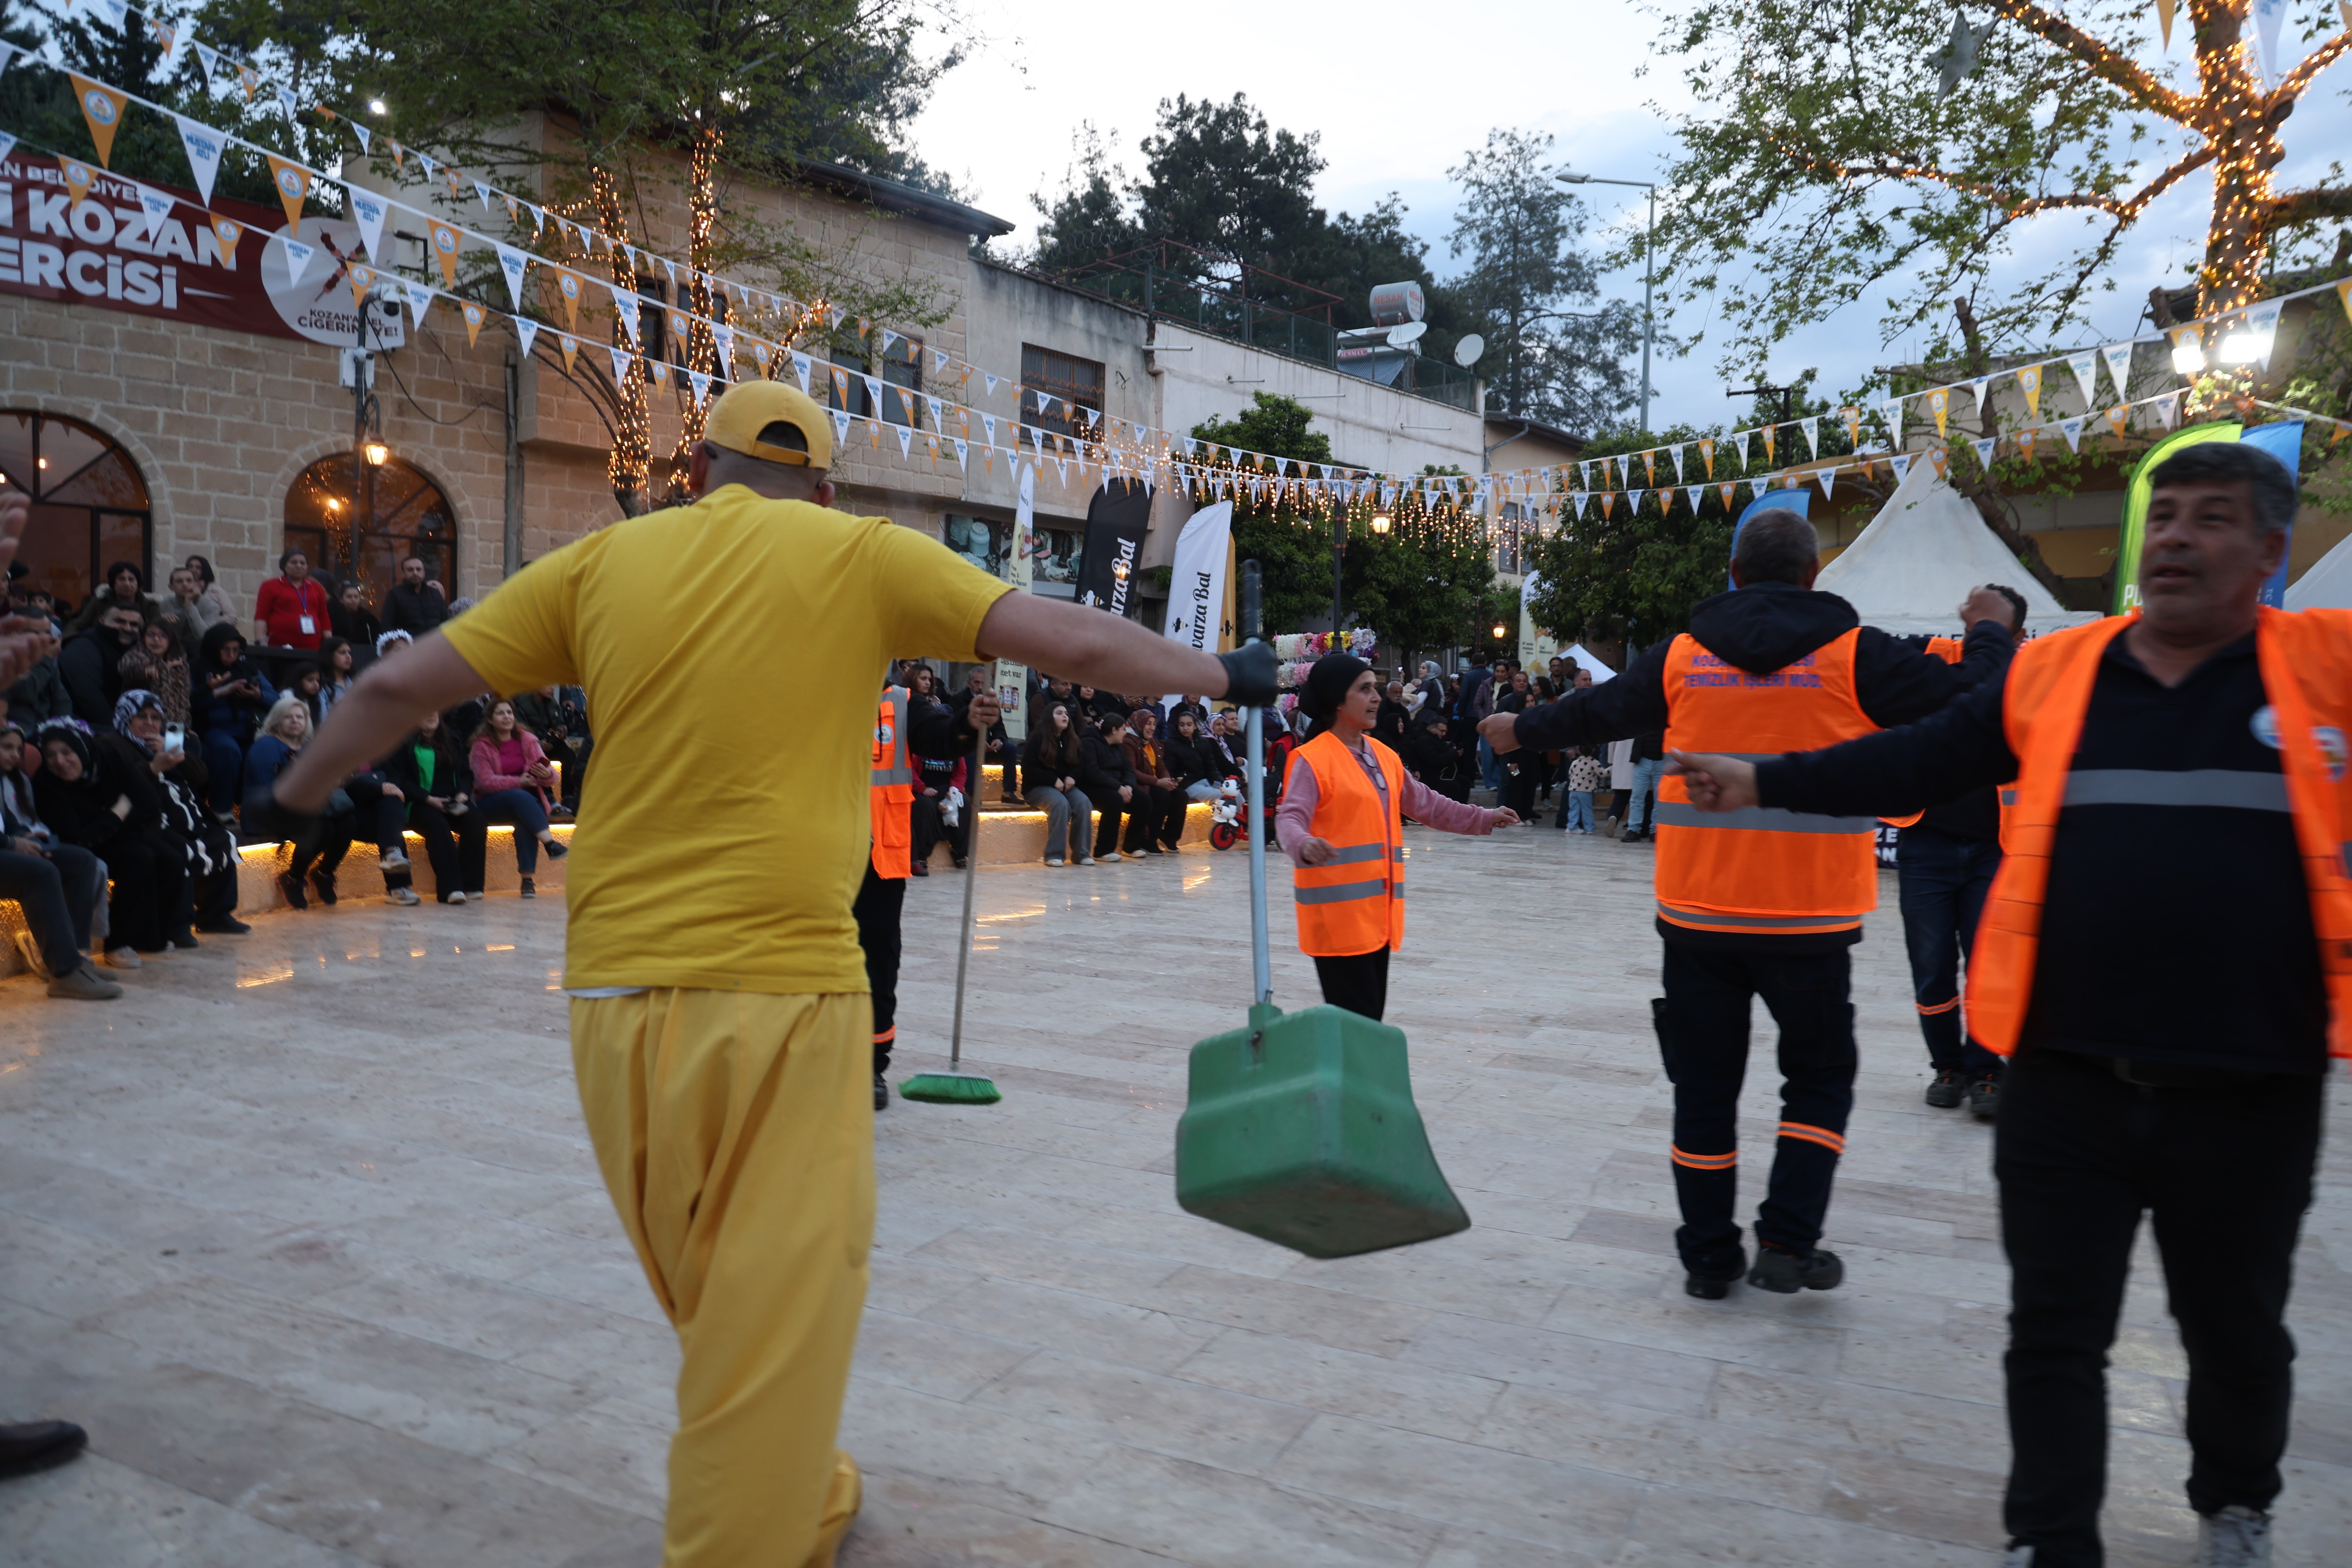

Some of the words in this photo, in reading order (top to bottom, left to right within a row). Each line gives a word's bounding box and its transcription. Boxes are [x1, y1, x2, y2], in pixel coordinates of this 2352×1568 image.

[186, 133, 217, 155] MUSTAFA
[355, 198, 380, 216] MUSTAFA
[28, 187, 237, 272] KOZAN
[502, 255, 522, 270] MUSTAFA
[1111, 537, 1136, 575] Bal
[1192, 571, 1211, 602] Bal
[1192, 604, 1208, 651] varza
[1691, 655, 1730, 667] KOZA
